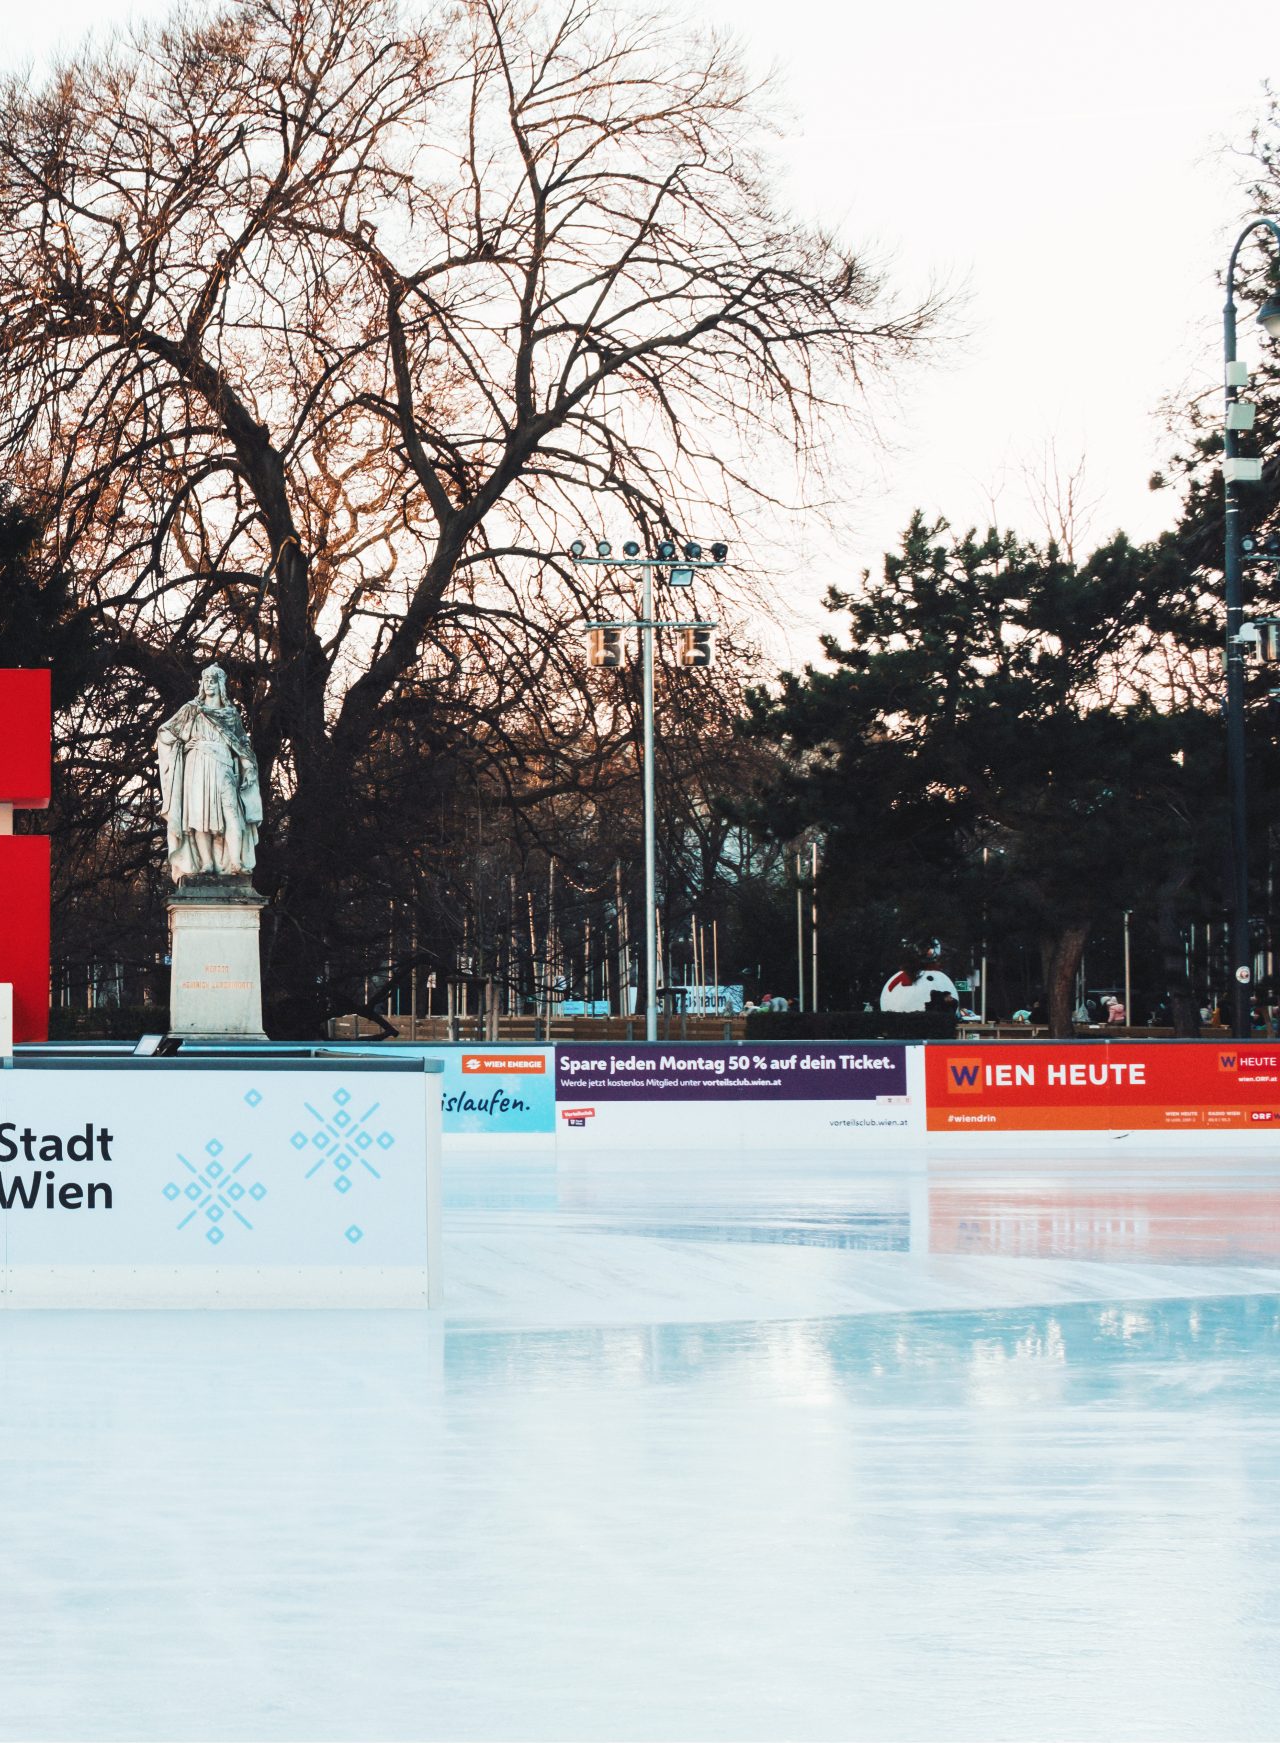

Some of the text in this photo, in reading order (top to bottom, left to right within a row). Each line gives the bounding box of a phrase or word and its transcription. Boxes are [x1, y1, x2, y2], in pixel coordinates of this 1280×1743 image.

[484, 1060, 542, 1068] WIEN ENERGIE
[560, 1055, 896, 1075] Spare jeden Montag 50 % auf dein Ticket.
[1220, 1056, 1277, 1068] W HEUTE
[950, 1063, 1146, 1086] WIEN HEUTE
[560, 1078, 782, 1089] Werde jetzt kostenlos Mitglied unter vorteilsclub.wien.at
[441, 1088, 531, 1115] islaufen.
[829, 1118, 908, 1127] vorteilsclub.wien.at
[947, 1114, 997, 1123] #wiendrin
